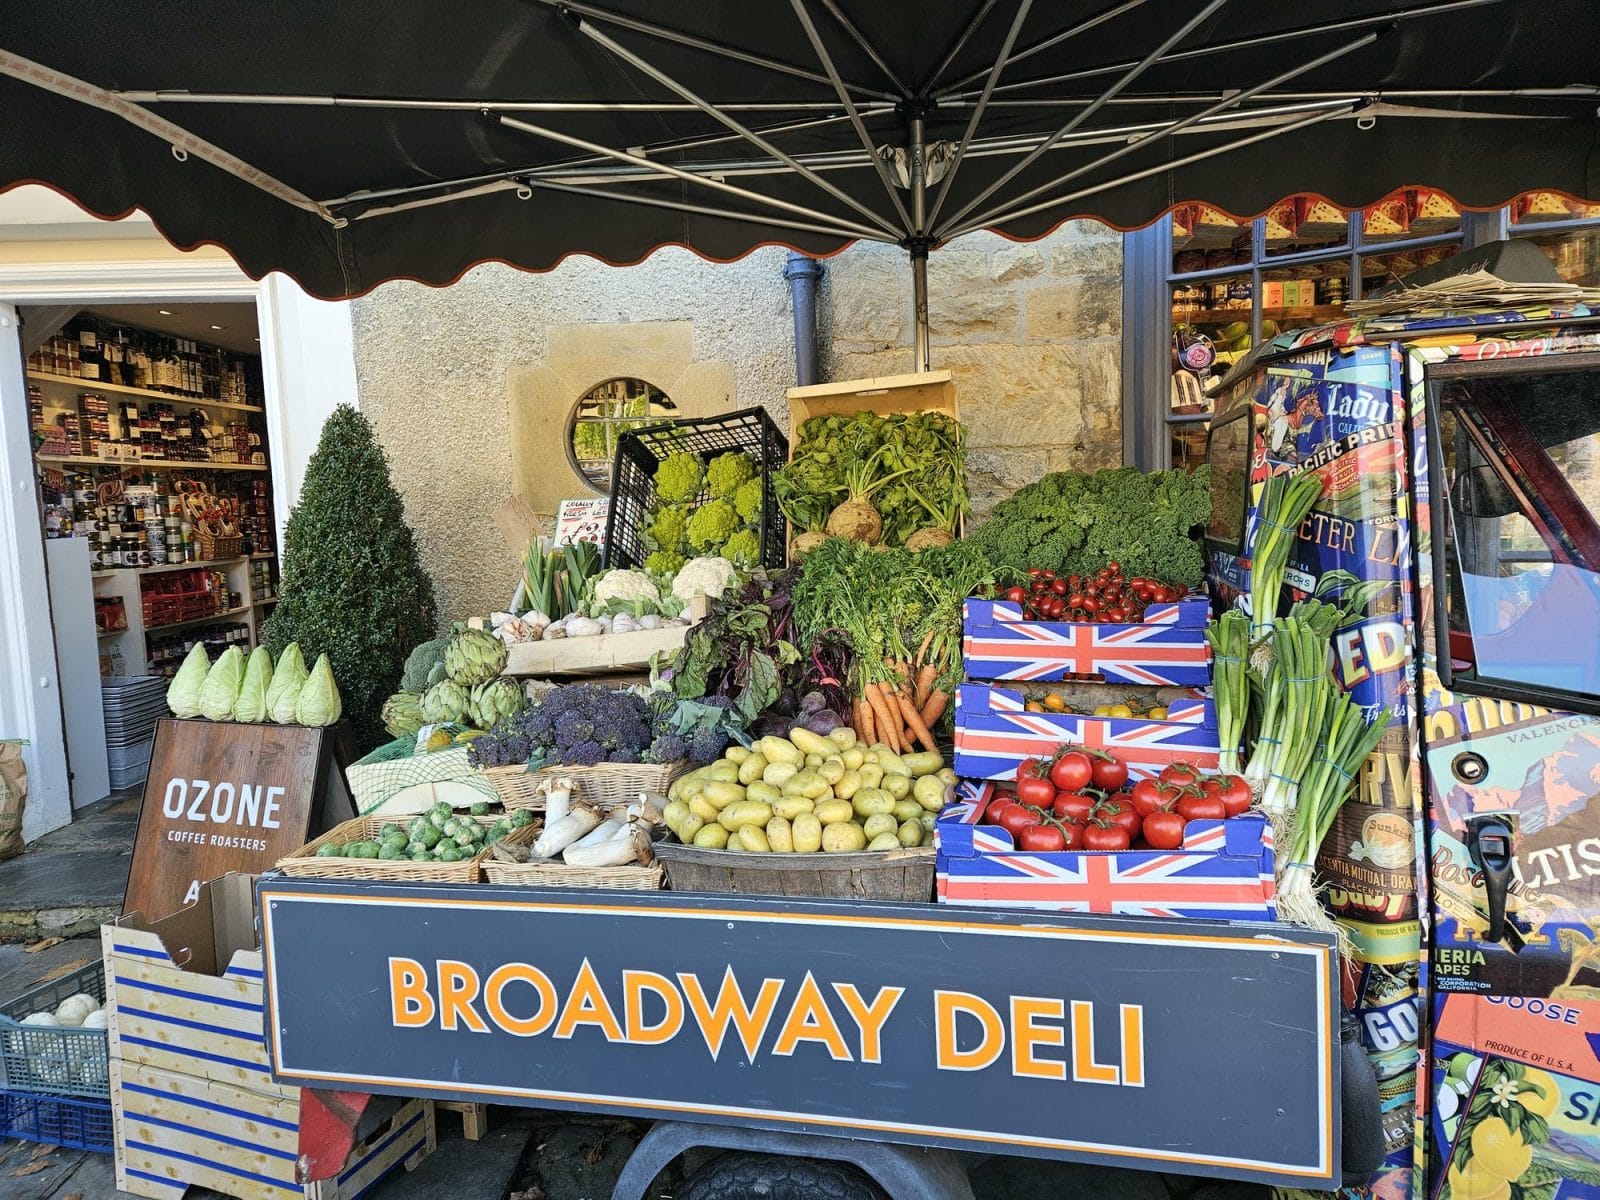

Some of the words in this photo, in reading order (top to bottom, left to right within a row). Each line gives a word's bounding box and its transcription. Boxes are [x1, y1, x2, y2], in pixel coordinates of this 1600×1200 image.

[1326, 383, 1390, 424] Lady
[1296, 511, 1355, 555] ETER
[162, 777, 286, 830] OZONE
[167, 830, 206, 845] COFFEE
[210, 836, 267, 851] ROASTERS
[1351, 865, 1388, 888] MUTUAL
[183, 880, 207, 905] A
[1440, 980, 1492, 989] CORPORATION
[387, 955, 905, 1065] BROADWAY
[934, 988, 1147, 1090] DELI
[1485, 1039, 1529, 1059] PRODUCE
[1531, 1053, 1545, 1063] OF
